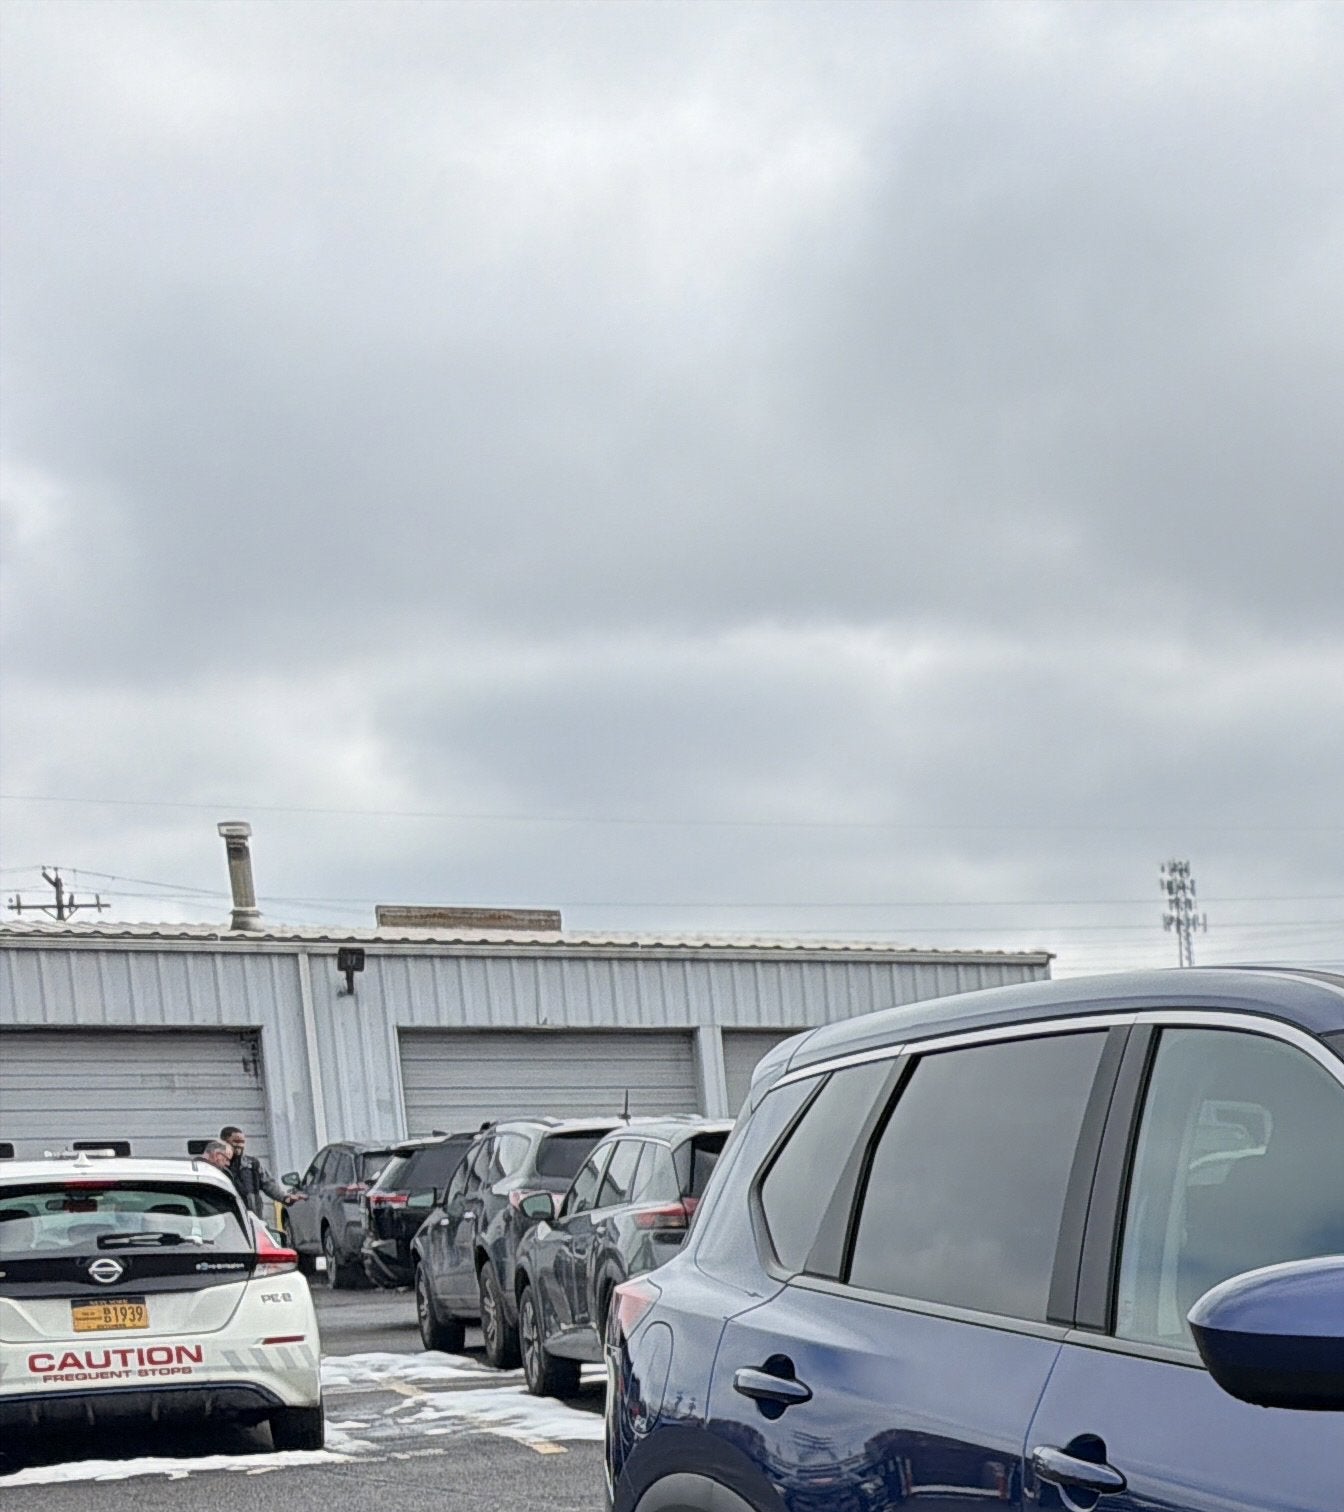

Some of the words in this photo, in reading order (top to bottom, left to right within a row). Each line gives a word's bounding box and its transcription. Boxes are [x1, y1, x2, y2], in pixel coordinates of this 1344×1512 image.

[28, 1345, 204, 1373] CAUTION
[43, 1370, 131, 1383] FREQUENT
[138, 1366, 193, 1378] STOPS
